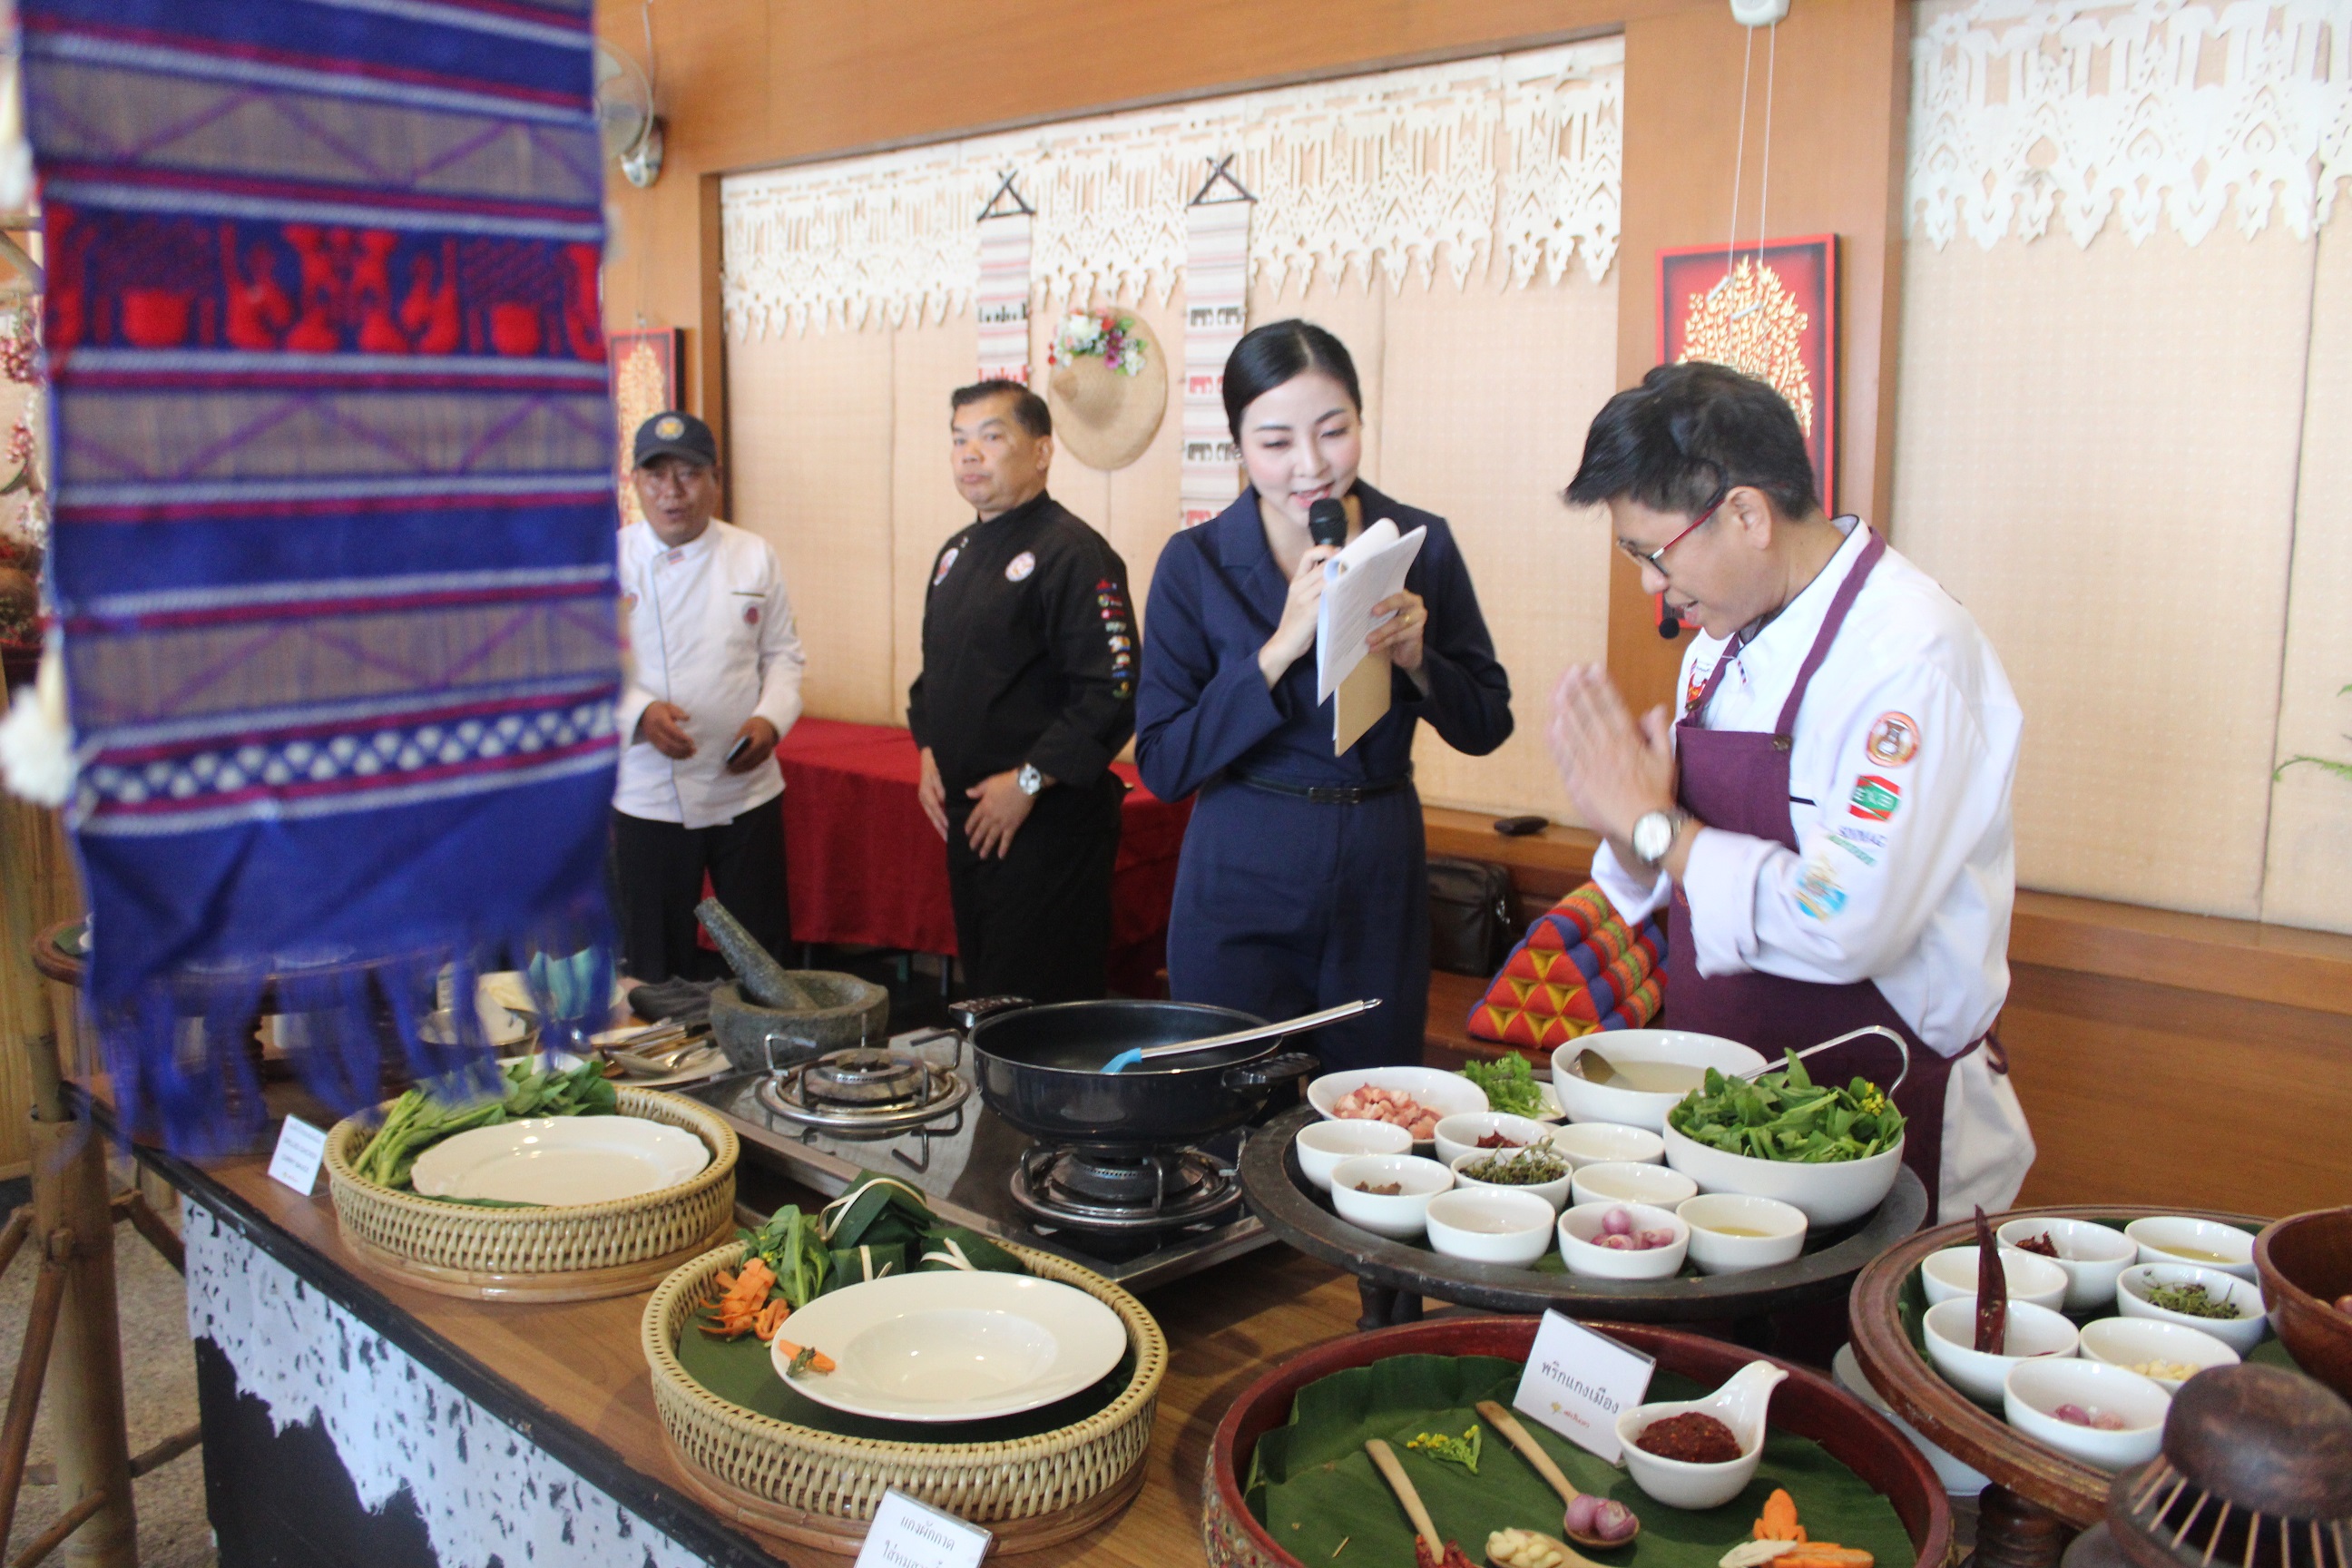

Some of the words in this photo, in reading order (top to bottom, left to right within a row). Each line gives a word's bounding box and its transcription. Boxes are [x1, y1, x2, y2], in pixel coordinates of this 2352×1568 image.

[1542, 1360, 1620, 1415] พริกแกงเมือง
[900, 1515, 956, 1552] แกงผักกาด
